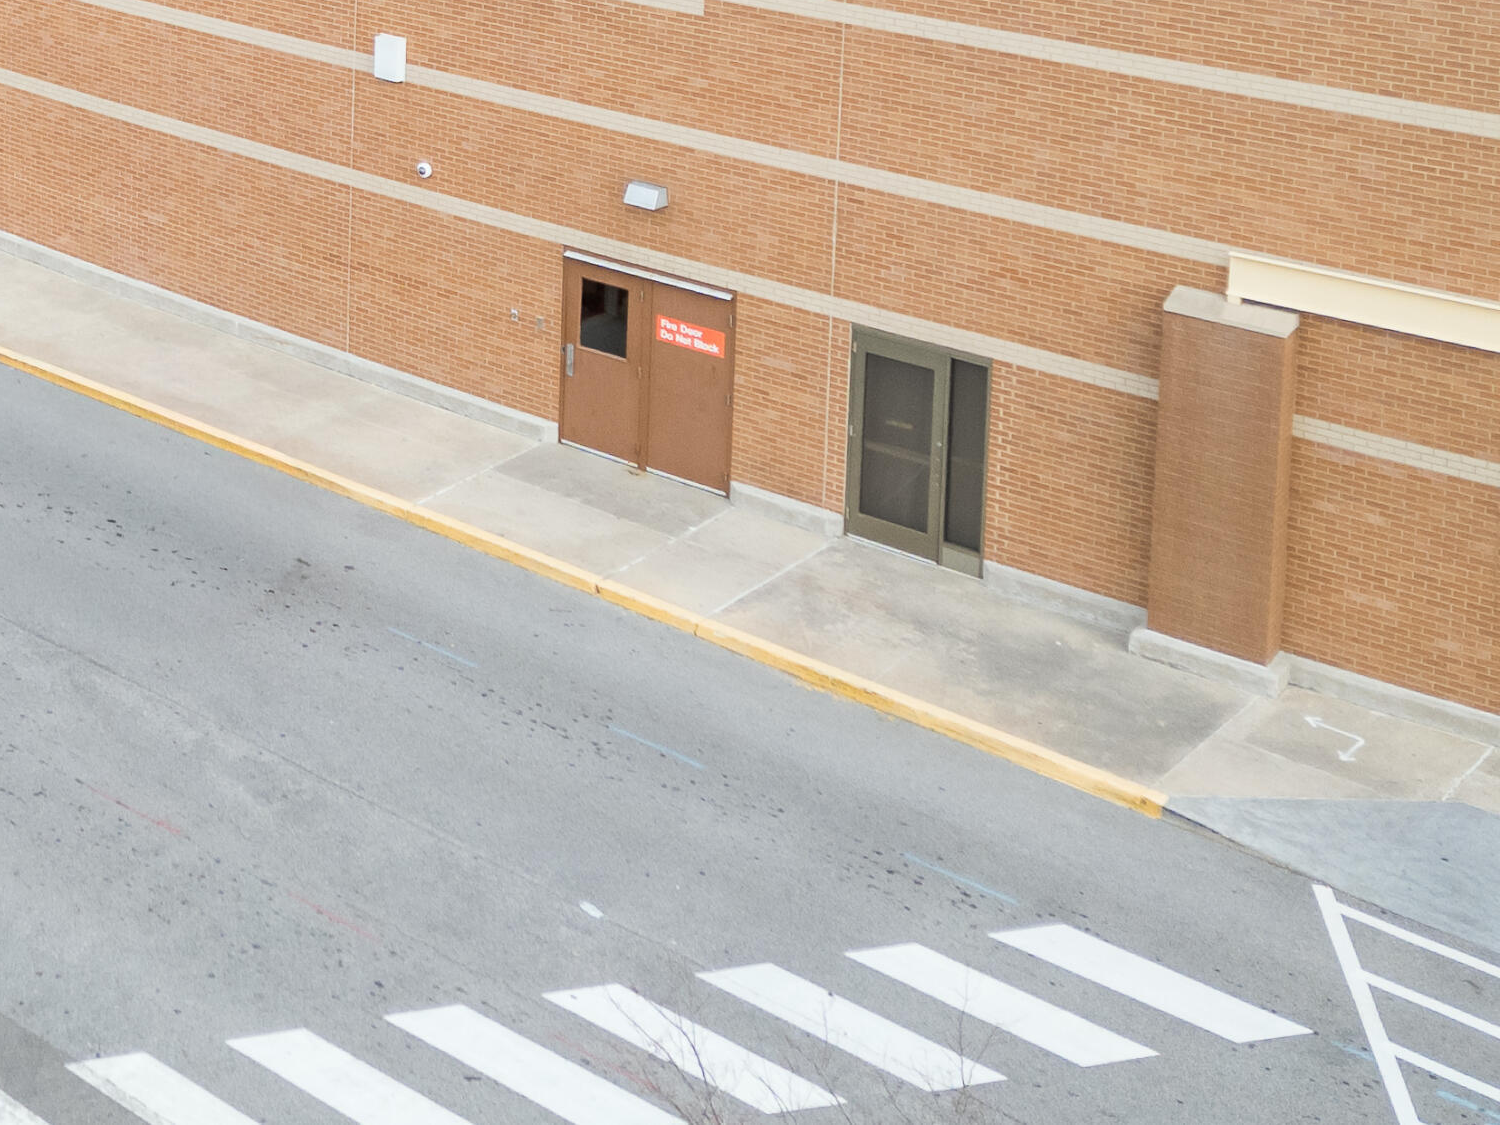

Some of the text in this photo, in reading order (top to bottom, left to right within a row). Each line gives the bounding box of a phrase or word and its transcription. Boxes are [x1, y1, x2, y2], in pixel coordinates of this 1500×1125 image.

[661, 319, 703, 337] Fire Door
[661, 329, 719, 353] Do Not Block
